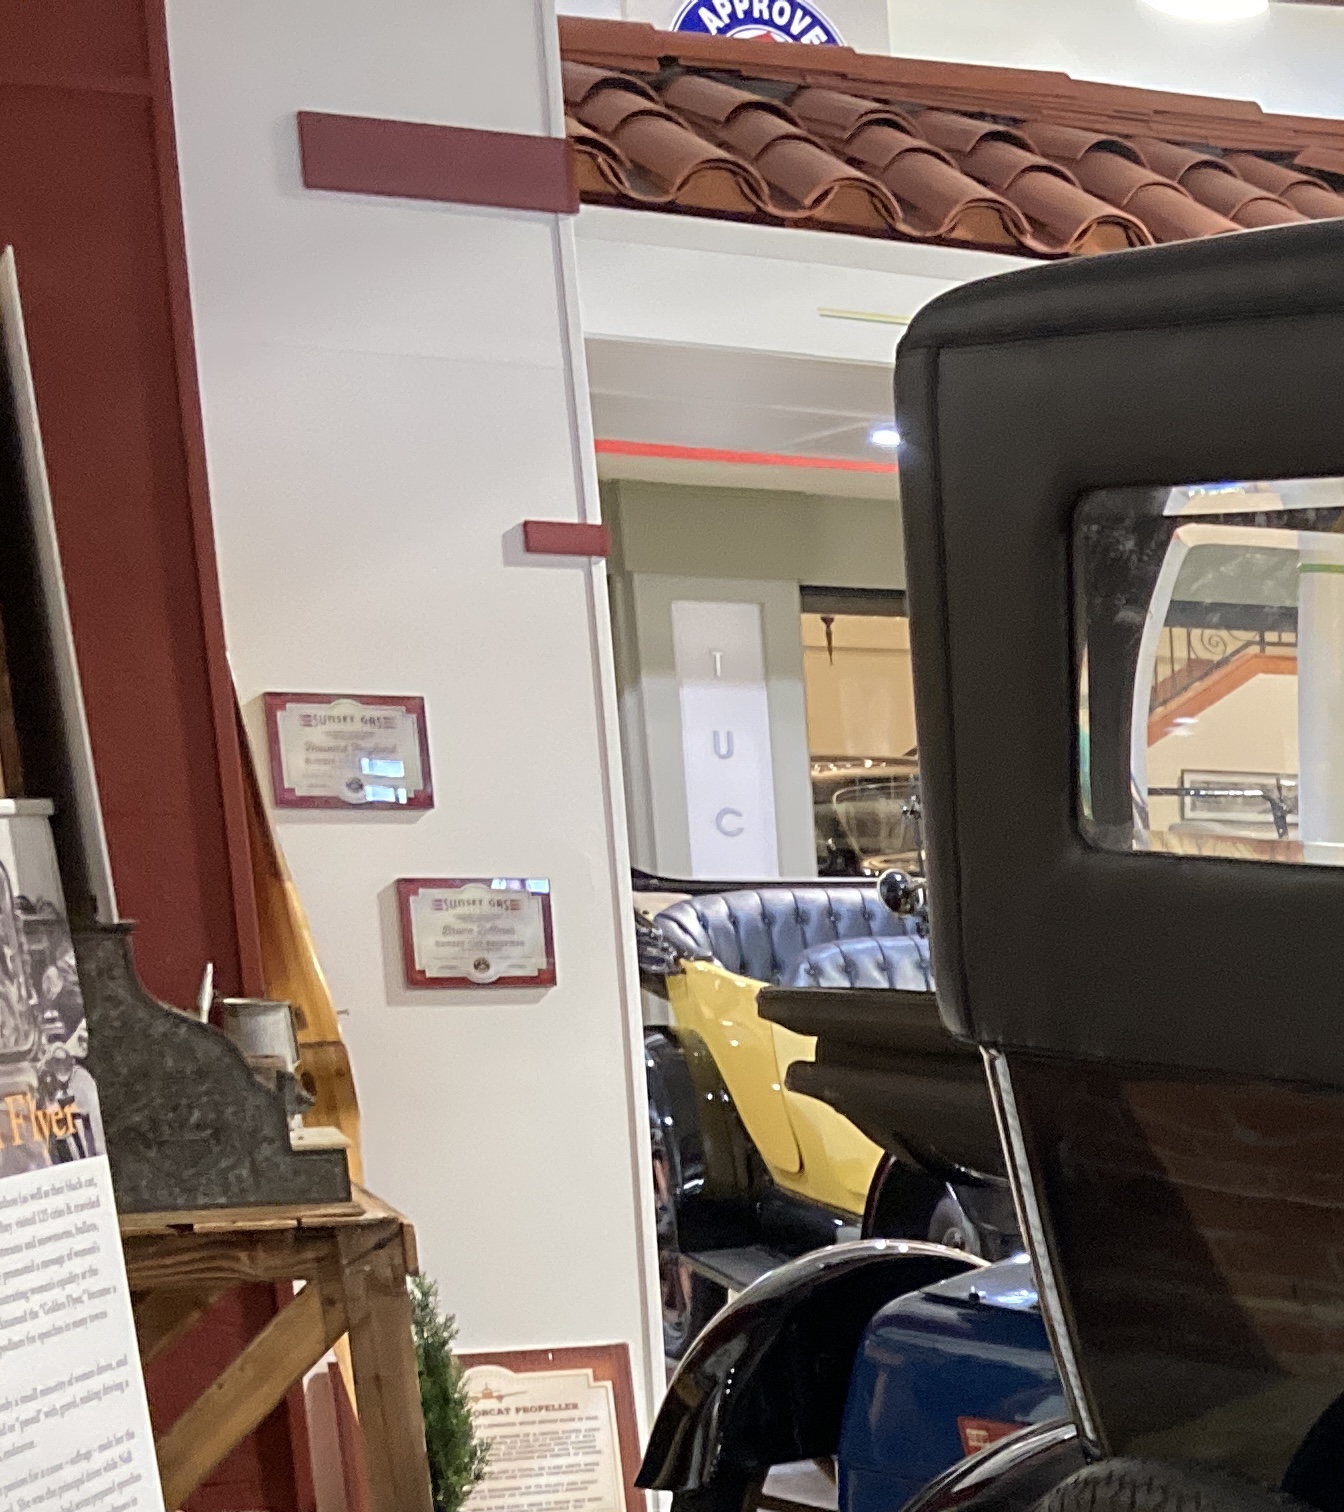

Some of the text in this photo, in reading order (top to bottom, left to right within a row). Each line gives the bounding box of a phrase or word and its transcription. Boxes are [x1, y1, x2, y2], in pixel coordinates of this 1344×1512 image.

[4, 1091, 77, 1166] Flyer
[472, 1402, 579, 1418] OBCAT PROPELLER
